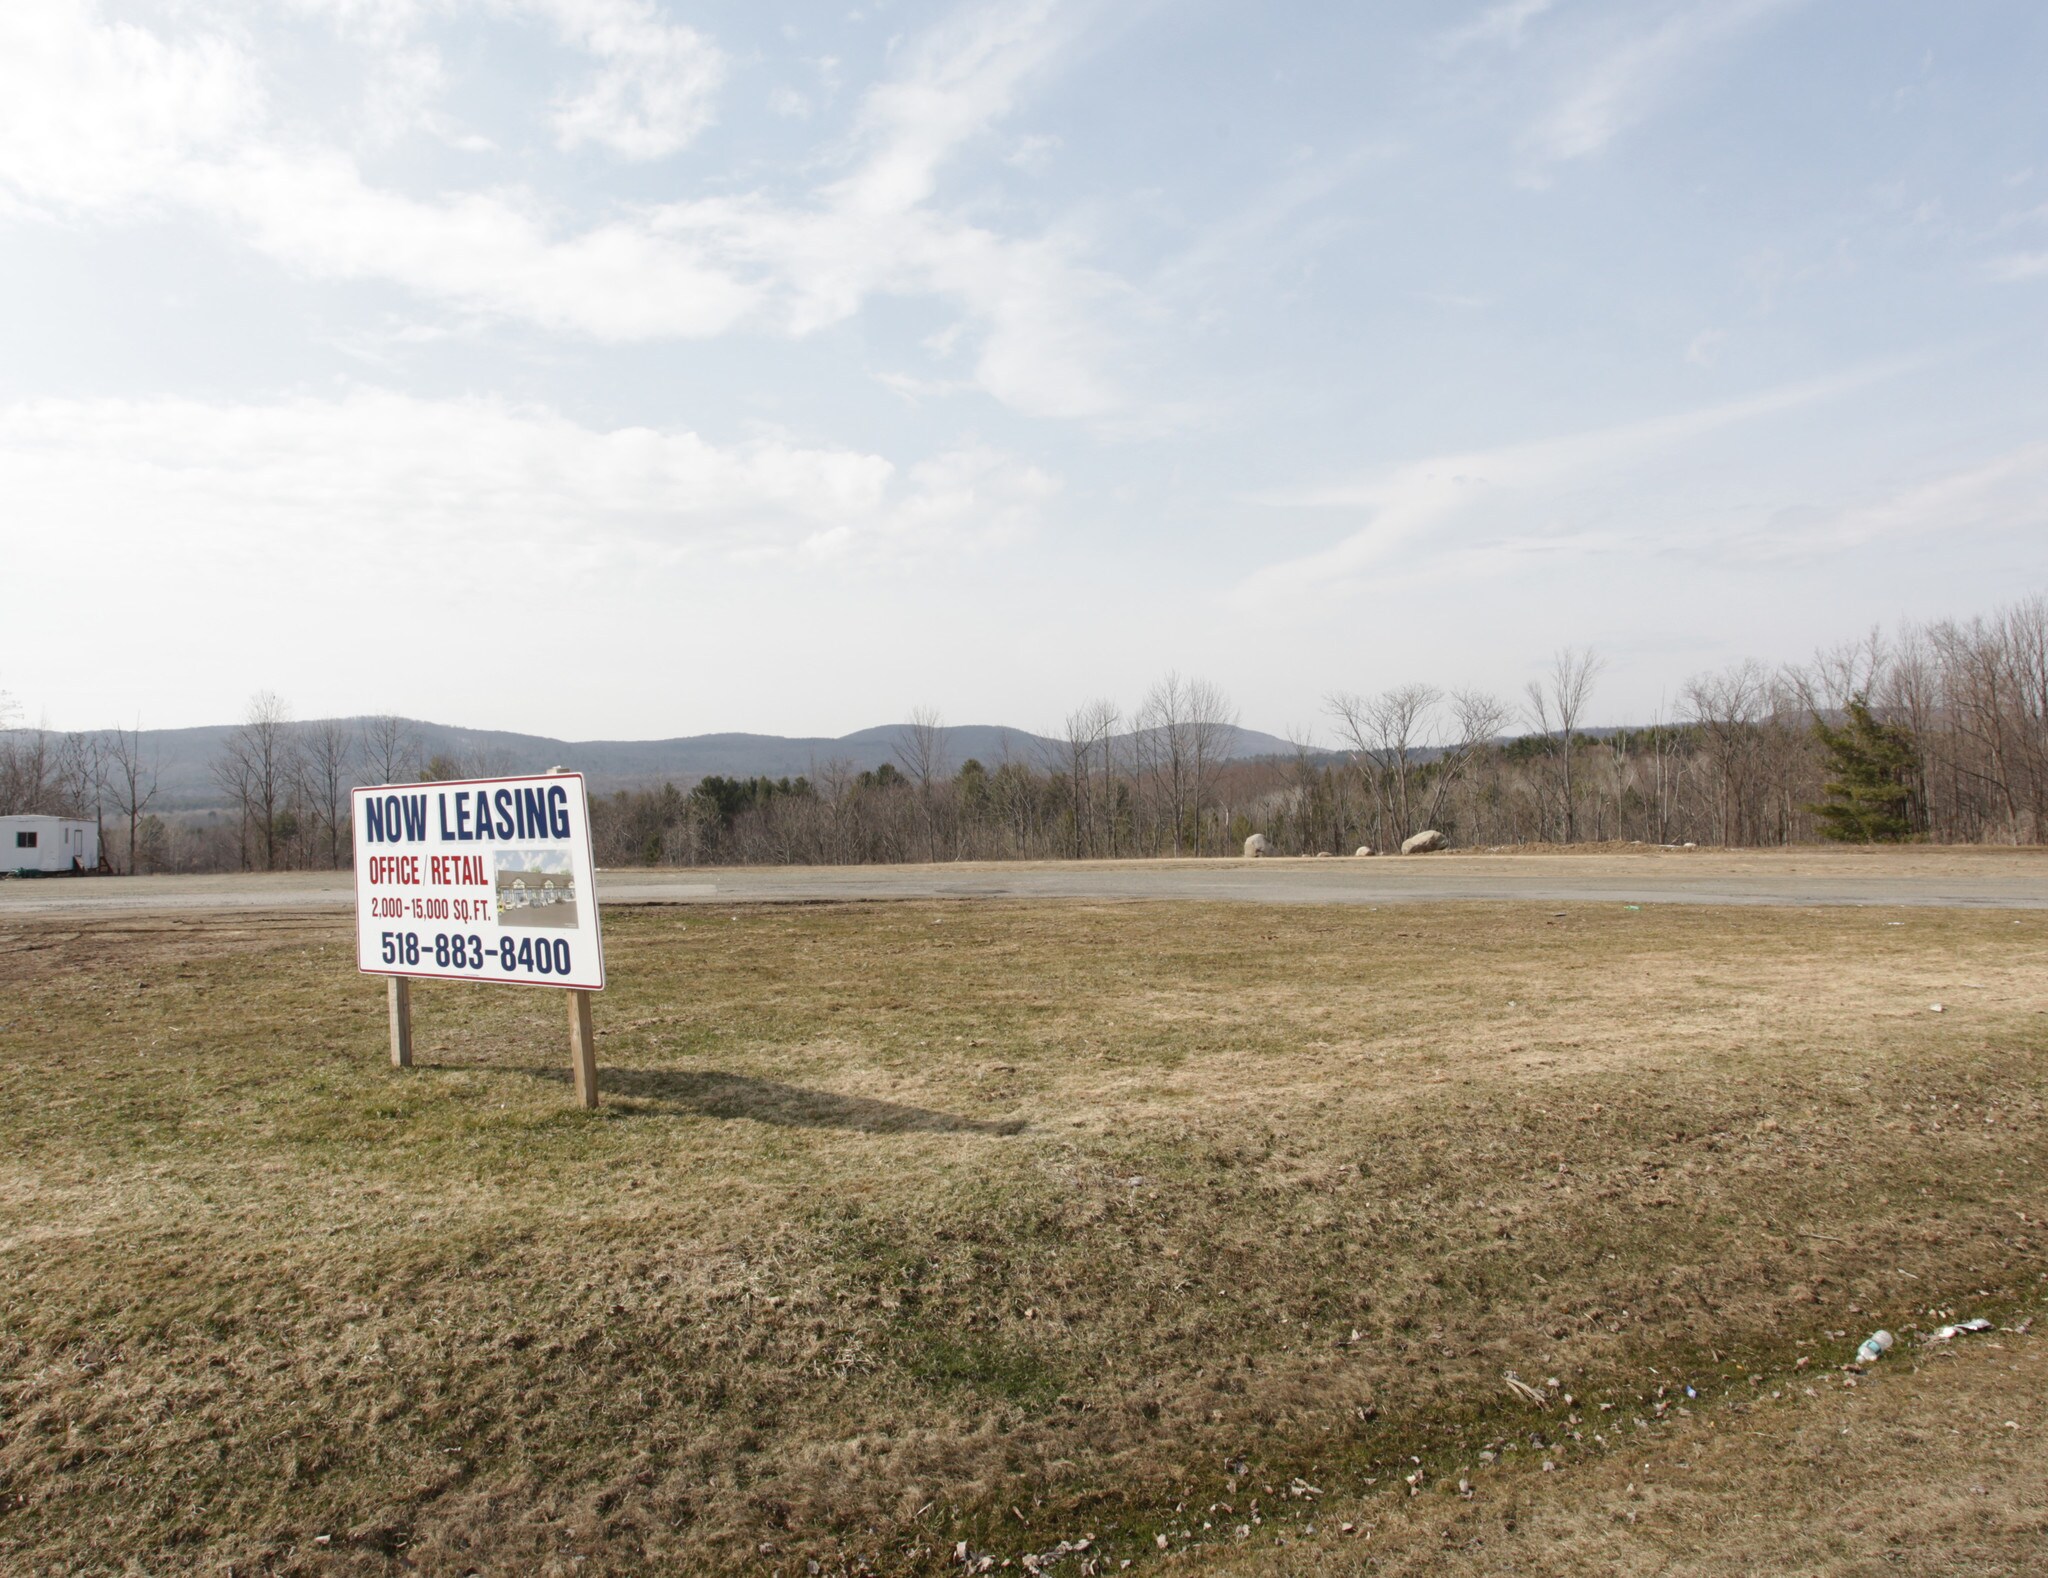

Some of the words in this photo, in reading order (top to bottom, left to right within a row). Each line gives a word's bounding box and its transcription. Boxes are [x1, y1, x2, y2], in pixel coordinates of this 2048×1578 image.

[366, 794, 427, 842] NOW
[439, 785, 571, 841] LEASING
[382, 932, 571, 975] 518-883-8400
